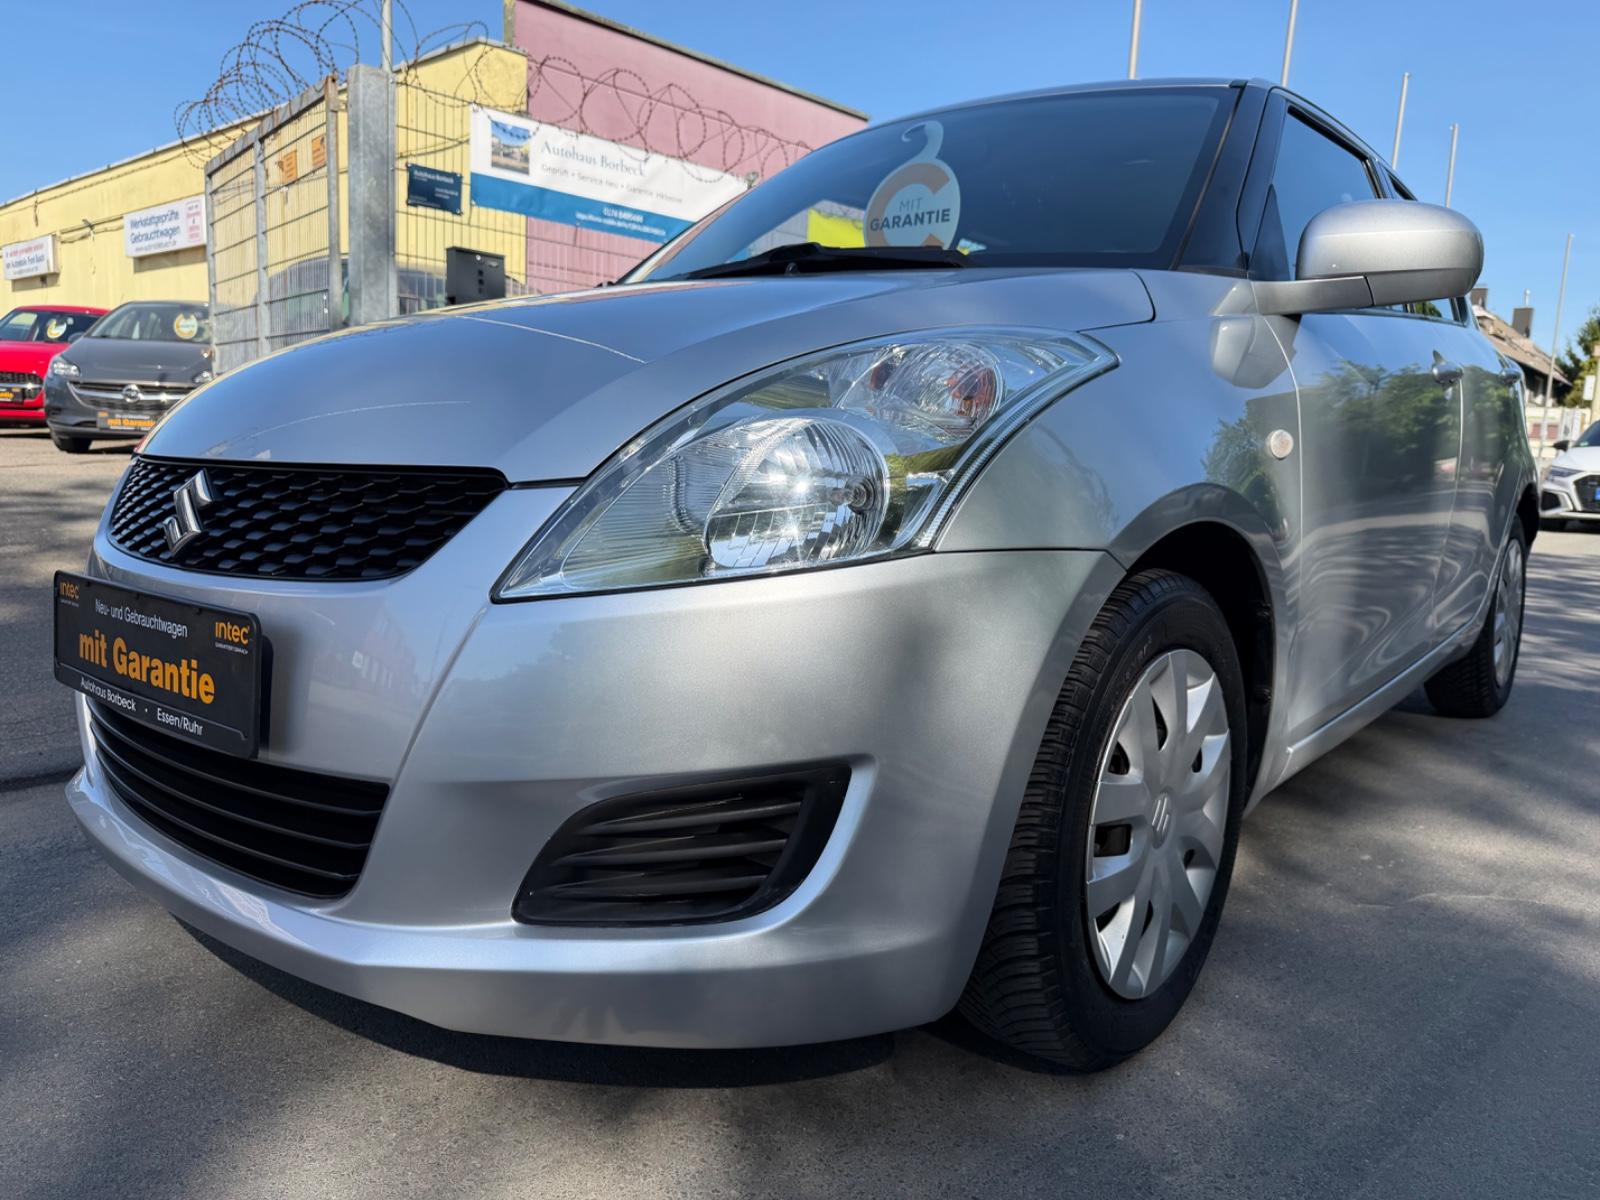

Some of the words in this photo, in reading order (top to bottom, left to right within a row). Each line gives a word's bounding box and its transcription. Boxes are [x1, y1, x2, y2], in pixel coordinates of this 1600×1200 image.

[541, 141, 597, 164] Autohaus
[600, 154, 645, 177] Borbeck
[899, 198, 923, 212] MIT
[870, 208, 951, 232] GARANTIE
[130, 225, 181, 244] Gebrauchtwagen
[59, 581, 80, 600] intec
[95, 599, 110, 616] Neu-
[110, 602, 123, 620] und
[124, 606, 188, 639] Gebrauchtwagen
[215, 621, 249, 645] intec
[79, 629, 107, 668] mit
[112, 637, 215, 705] Garantie
[80, 677, 107, 700] Autohaus
[106, 688, 137, 712] Borbeck
[157, 707, 204, 737] Essen/Ruhr
